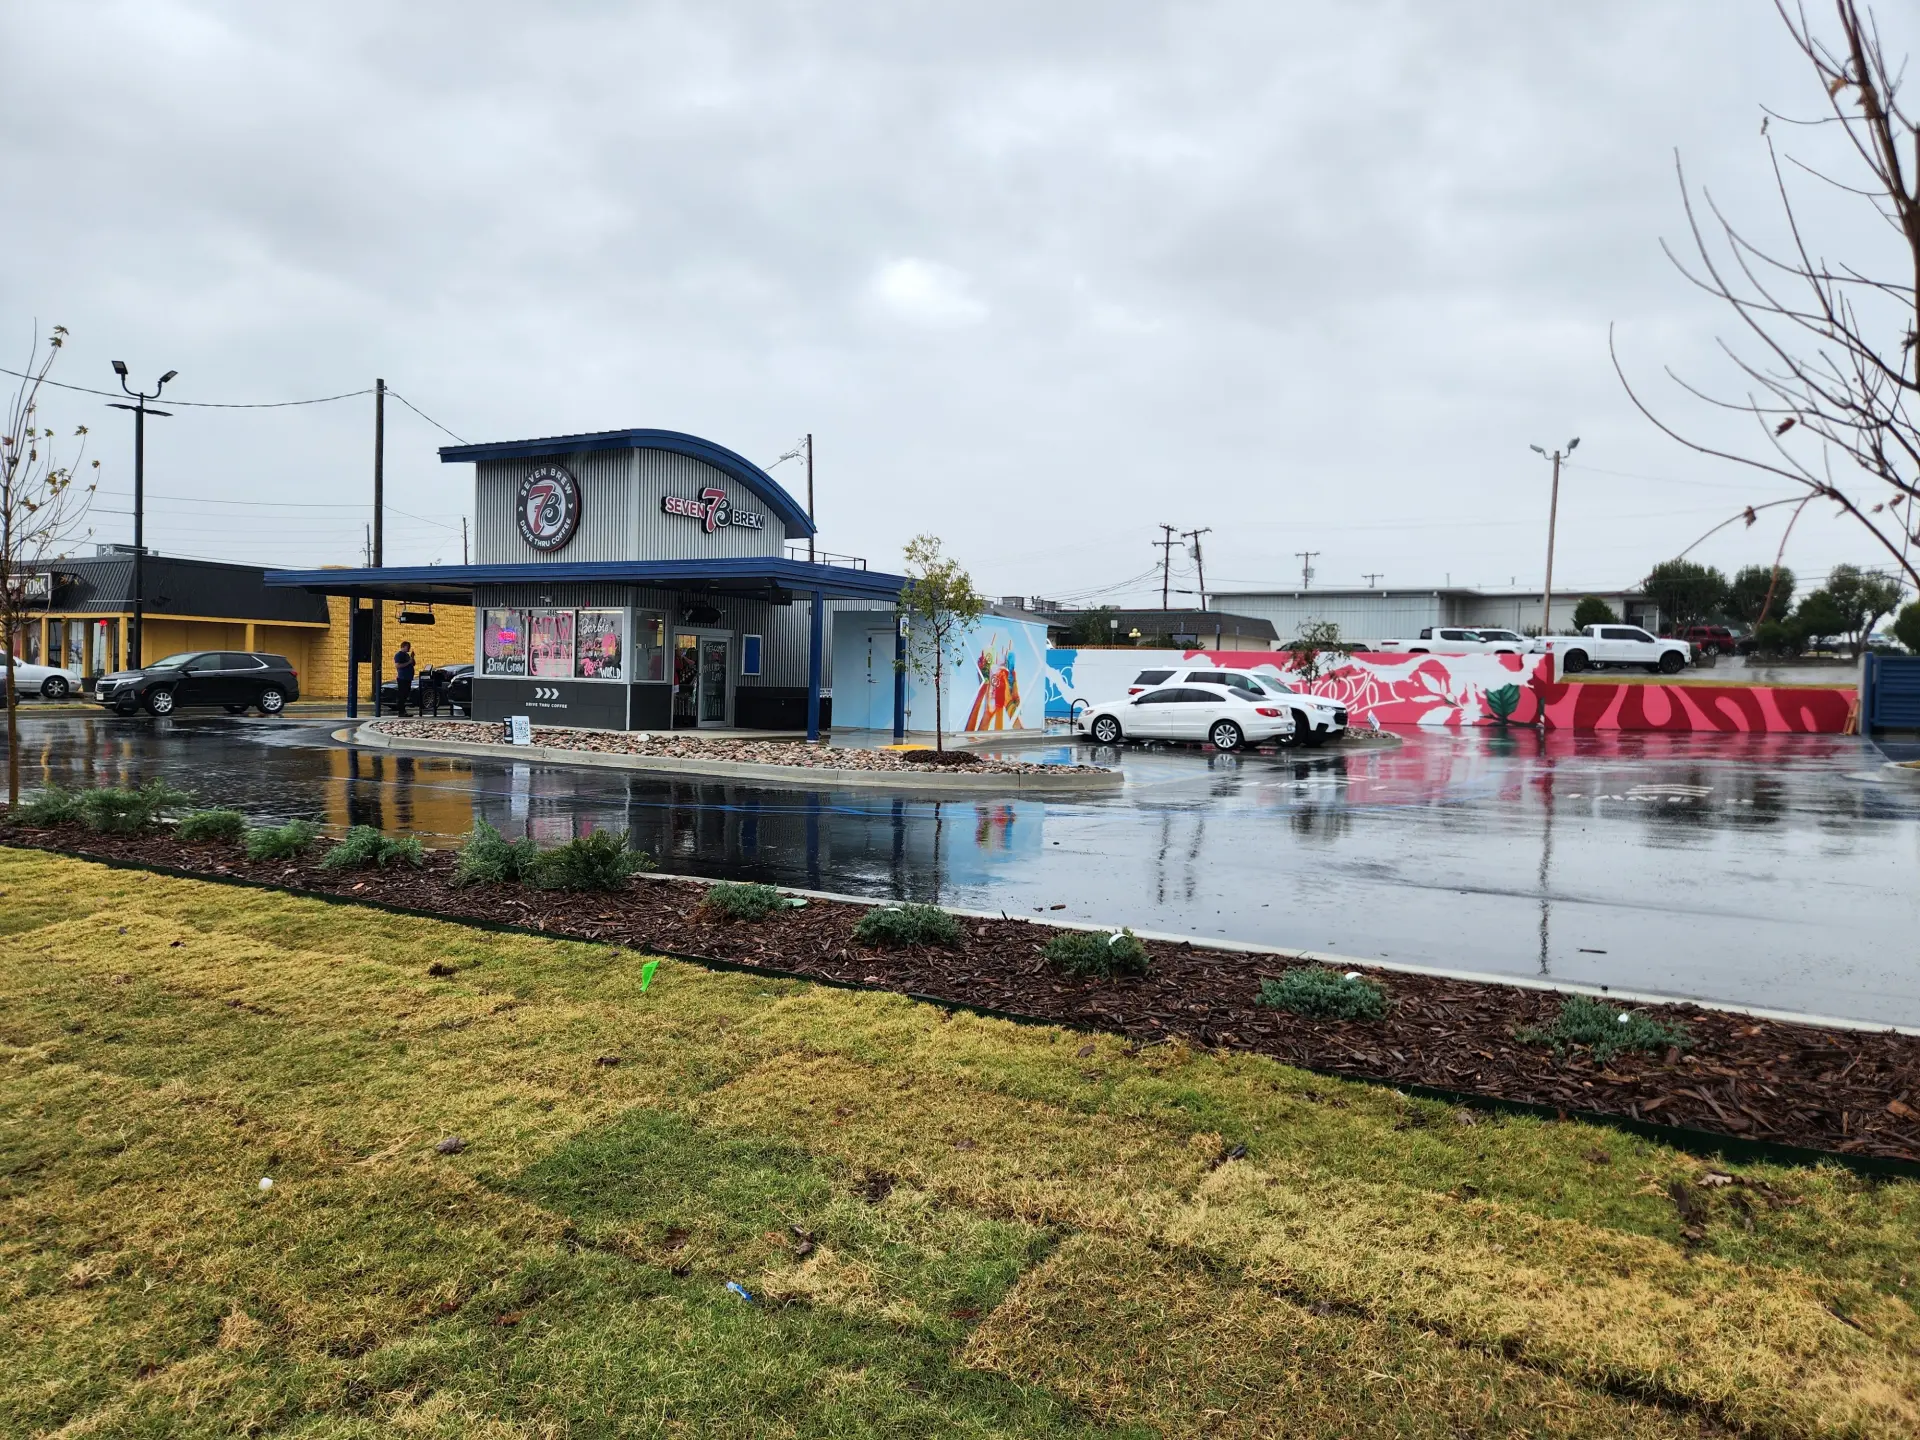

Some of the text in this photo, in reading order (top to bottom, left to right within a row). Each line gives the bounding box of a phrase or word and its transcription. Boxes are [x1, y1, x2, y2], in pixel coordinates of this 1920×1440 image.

[521, 467, 573, 497] SEVEN BREW
[665, 496, 706, 519] SEVEN
[732, 509, 765, 529] BREW
[519, 517, 572, 547] DRIVE THRU COFFEE
[532, 616, 572, 645] NOW
[530, 644, 573, 676] OPEN
[600, 665, 621, 679] WORLD
